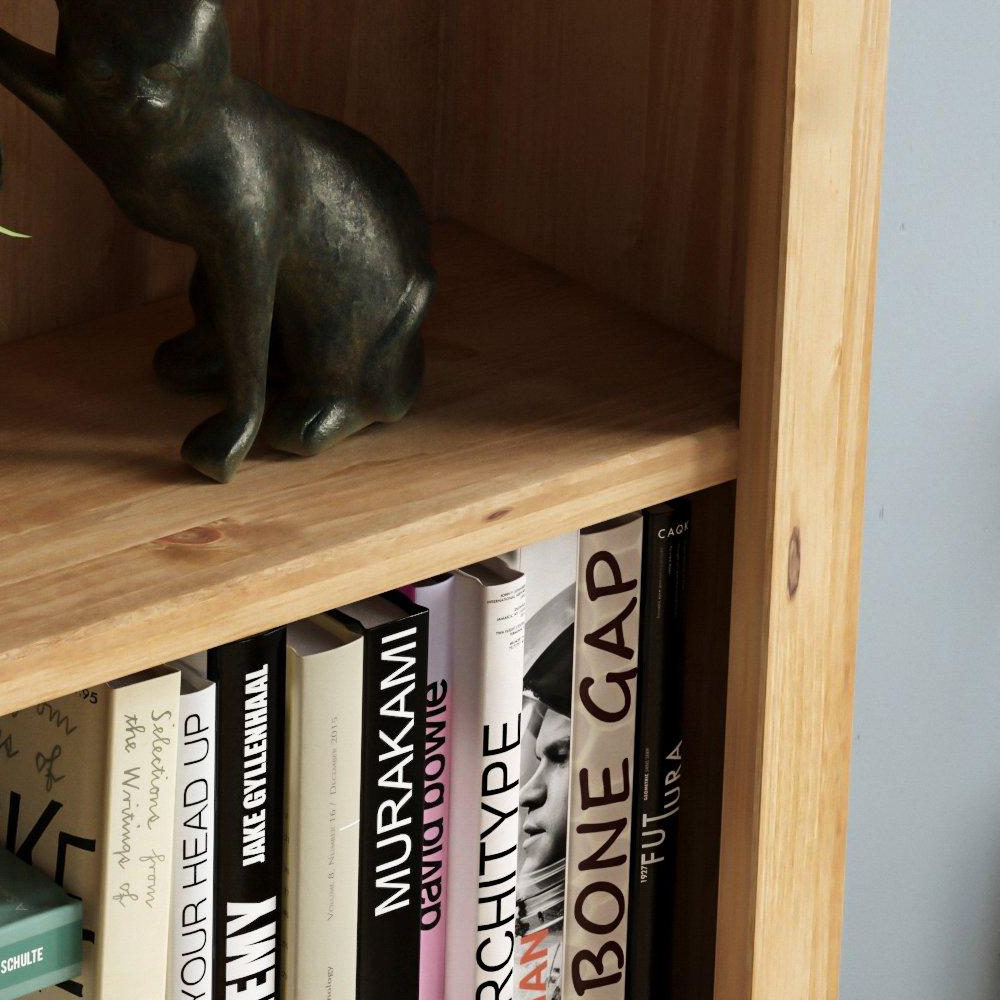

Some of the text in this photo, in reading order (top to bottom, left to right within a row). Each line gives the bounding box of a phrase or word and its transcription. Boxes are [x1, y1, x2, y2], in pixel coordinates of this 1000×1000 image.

[112, 713, 146, 908] the Writings of
[139, 709, 172, 909] Selections from
[180, 713, 210, 1000] YOUR HEAD UP
[242, 664, 268, 867] JAKE GYLLENHAAL
[374, 626, 417, 917] MURAKAMI
[571, 550, 638, 998] BONE GAP
[0, 946, 44, 975] SCHULTE
[225, 895, 277, 1000] EMY
[518, 926, 550, 1000] AN
[640, 865, 648, 884] 1927
